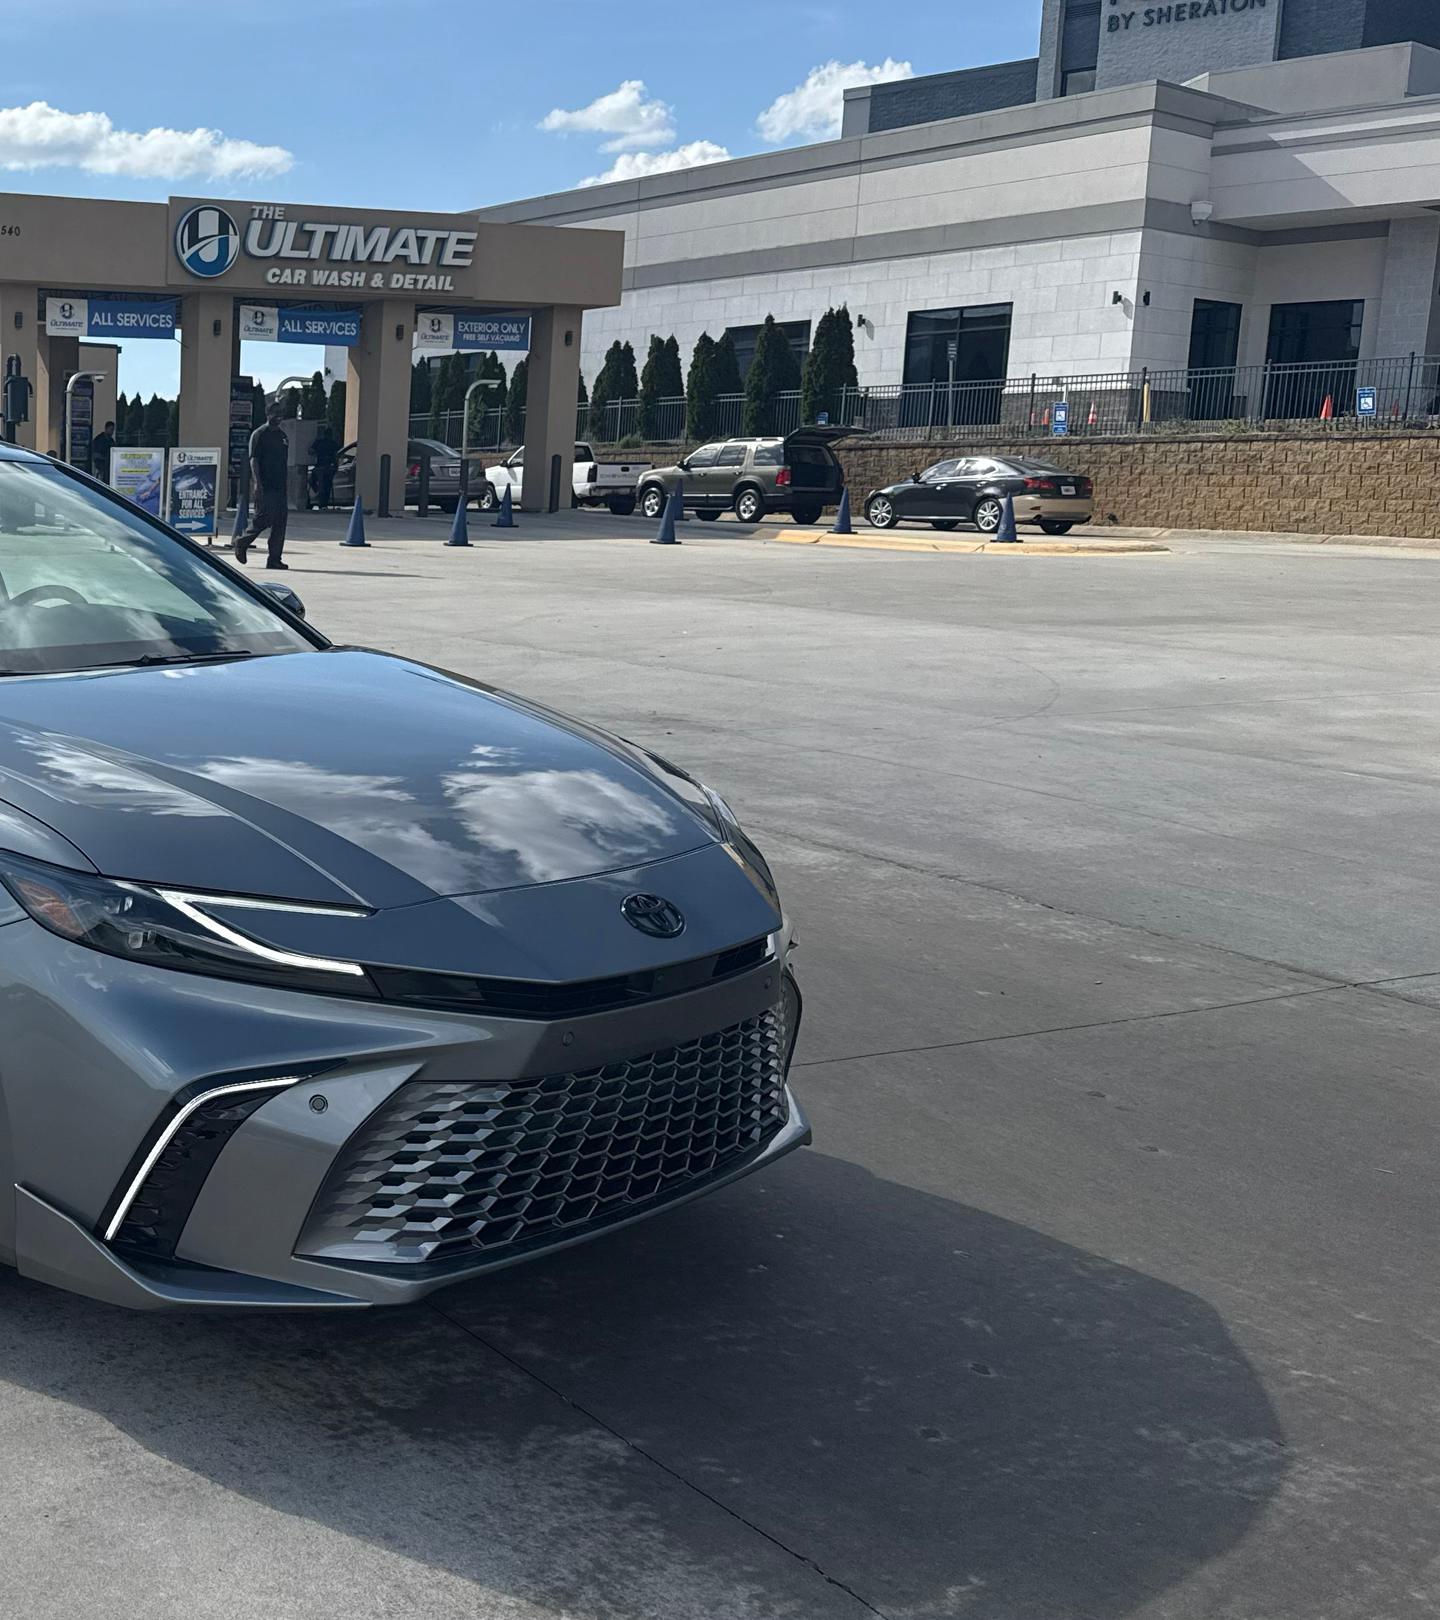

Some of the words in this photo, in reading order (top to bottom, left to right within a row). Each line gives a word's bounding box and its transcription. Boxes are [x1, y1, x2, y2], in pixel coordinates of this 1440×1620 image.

[1107, 11, 1135, 33] BY
[251, 205, 286, 220] THE
[244, 218, 478, 268] ULTIMATE
[266, 267, 307, 285] CAR
[312, 269, 367, 288] WASH
[370, 272, 385, 288] &
[389, 273, 455, 292] DETAIL
[91, 312, 114, 326] ALL
[116, 313, 173, 328] SERVICES
[458, 321, 499, 333] EXTERIOR
[500, 322, 526, 334] ONLY
[281, 320, 303, 333] ALL
[305, 320, 357, 336] SERVICES
[463, 333, 475, 341] FREE
[490, 333, 520, 343] VACUUMS
[179, 489, 208, 500] ENTRANCE
[181, 499, 193, 509] FOR
[193, 499, 204, 509] ALL
[178, 508, 206, 519] SERVICES
